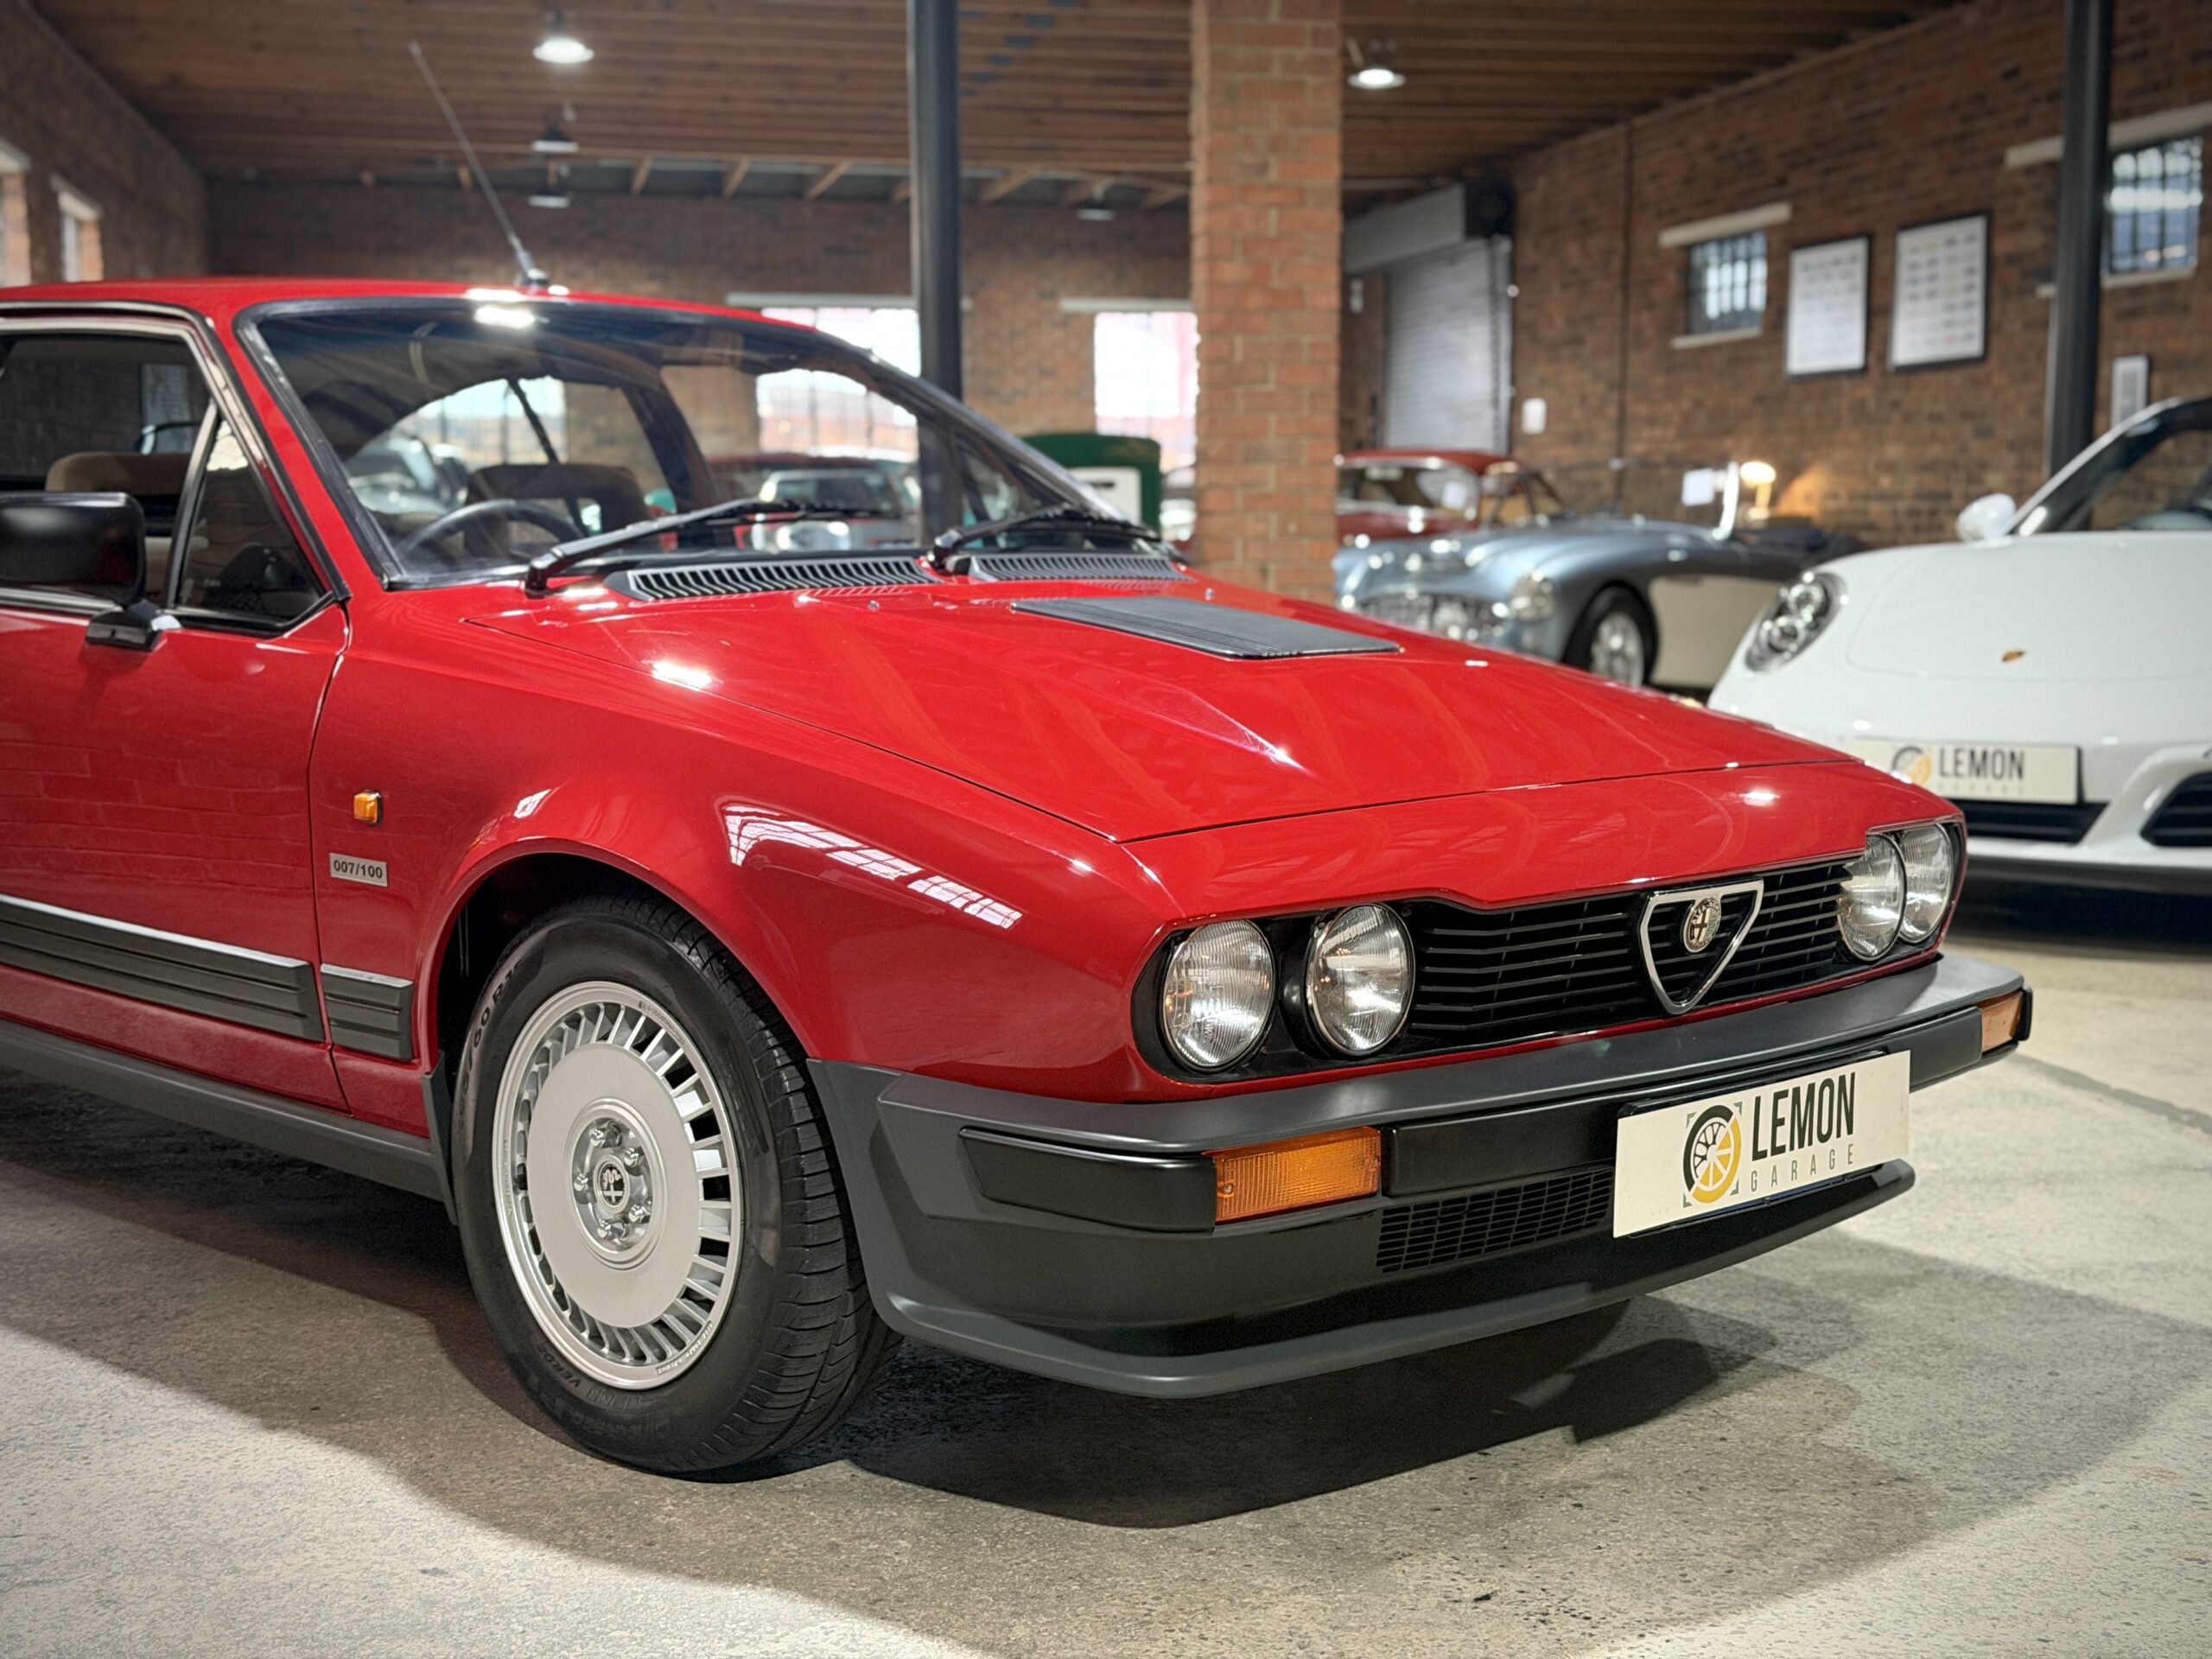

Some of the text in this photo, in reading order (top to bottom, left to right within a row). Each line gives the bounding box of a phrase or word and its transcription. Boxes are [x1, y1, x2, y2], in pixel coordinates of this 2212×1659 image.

[1939, 747, 2025, 780] LEMON
[334, 860, 383, 879] 007/100
[1751, 1071, 1856, 1161] LEMON
[1751, 1143, 1854, 1192] GARAGE
